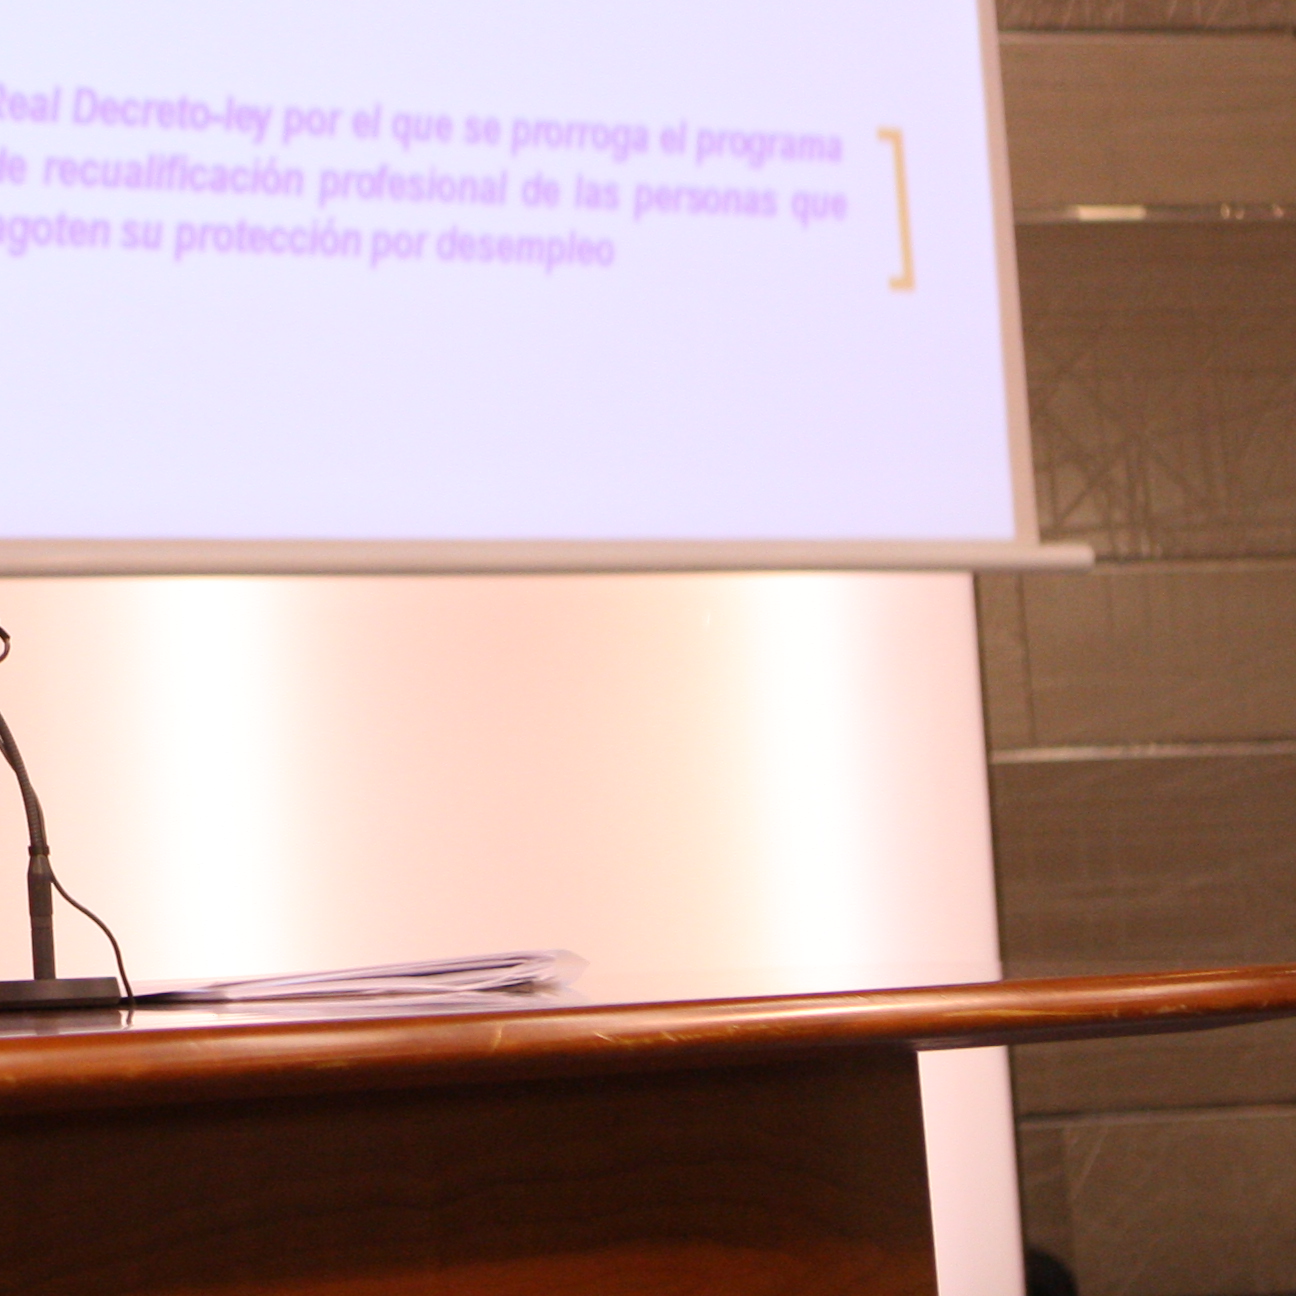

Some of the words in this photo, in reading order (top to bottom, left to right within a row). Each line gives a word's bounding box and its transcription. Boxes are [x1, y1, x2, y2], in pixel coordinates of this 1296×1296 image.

[72, 85, 272, 145] Decreto-ley
[281, 103, 342, 145] por
[352, 103, 382, 139] el
[392, 110, 452, 151] que
[464, 113, 501, 145] se
[511, 117, 649, 164] prorroga
[660, 119, 688, 155] el
[696, 126, 843, 170] programa
[43, 152, 304, 197] recualificación
[318, 163, 508, 209] profesional
[522, 171, 560, 207] de
[575, 174, 620, 211] las
[634, 181, 778, 222] personas
[792, 188, 848, 230] que
[121, 217, 163, 251] su
[174, 216, 361, 263] protección
[371, 226, 427, 269] por
[436, 225, 615, 275] desempleo
